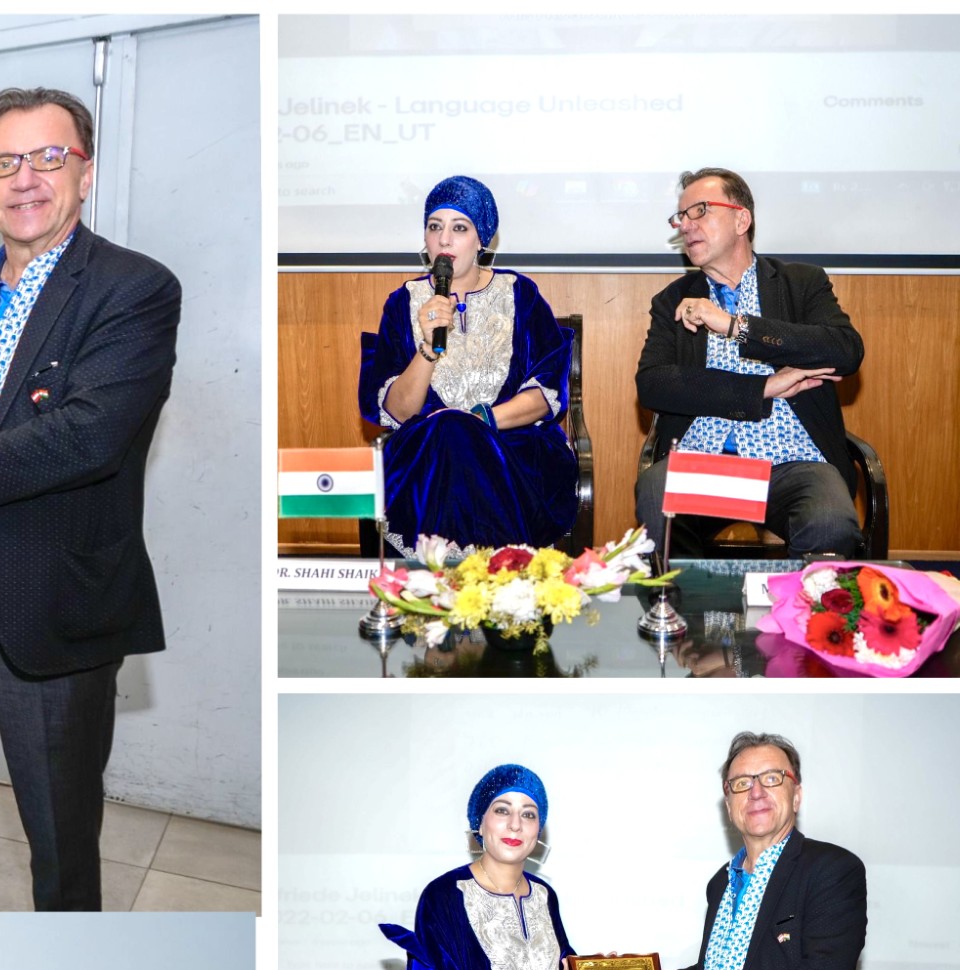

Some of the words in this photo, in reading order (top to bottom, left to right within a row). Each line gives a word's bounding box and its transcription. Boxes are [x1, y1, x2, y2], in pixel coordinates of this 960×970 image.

[395, 95, 531, 117] Language
[539, 93, 683, 113] Unleashed
[823, 94, 925, 108] Comments
[278, 567, 291, 578] R.
[294, 567, 335, 579] SHAHI
[338, 568, 378, 579] SHAIK
